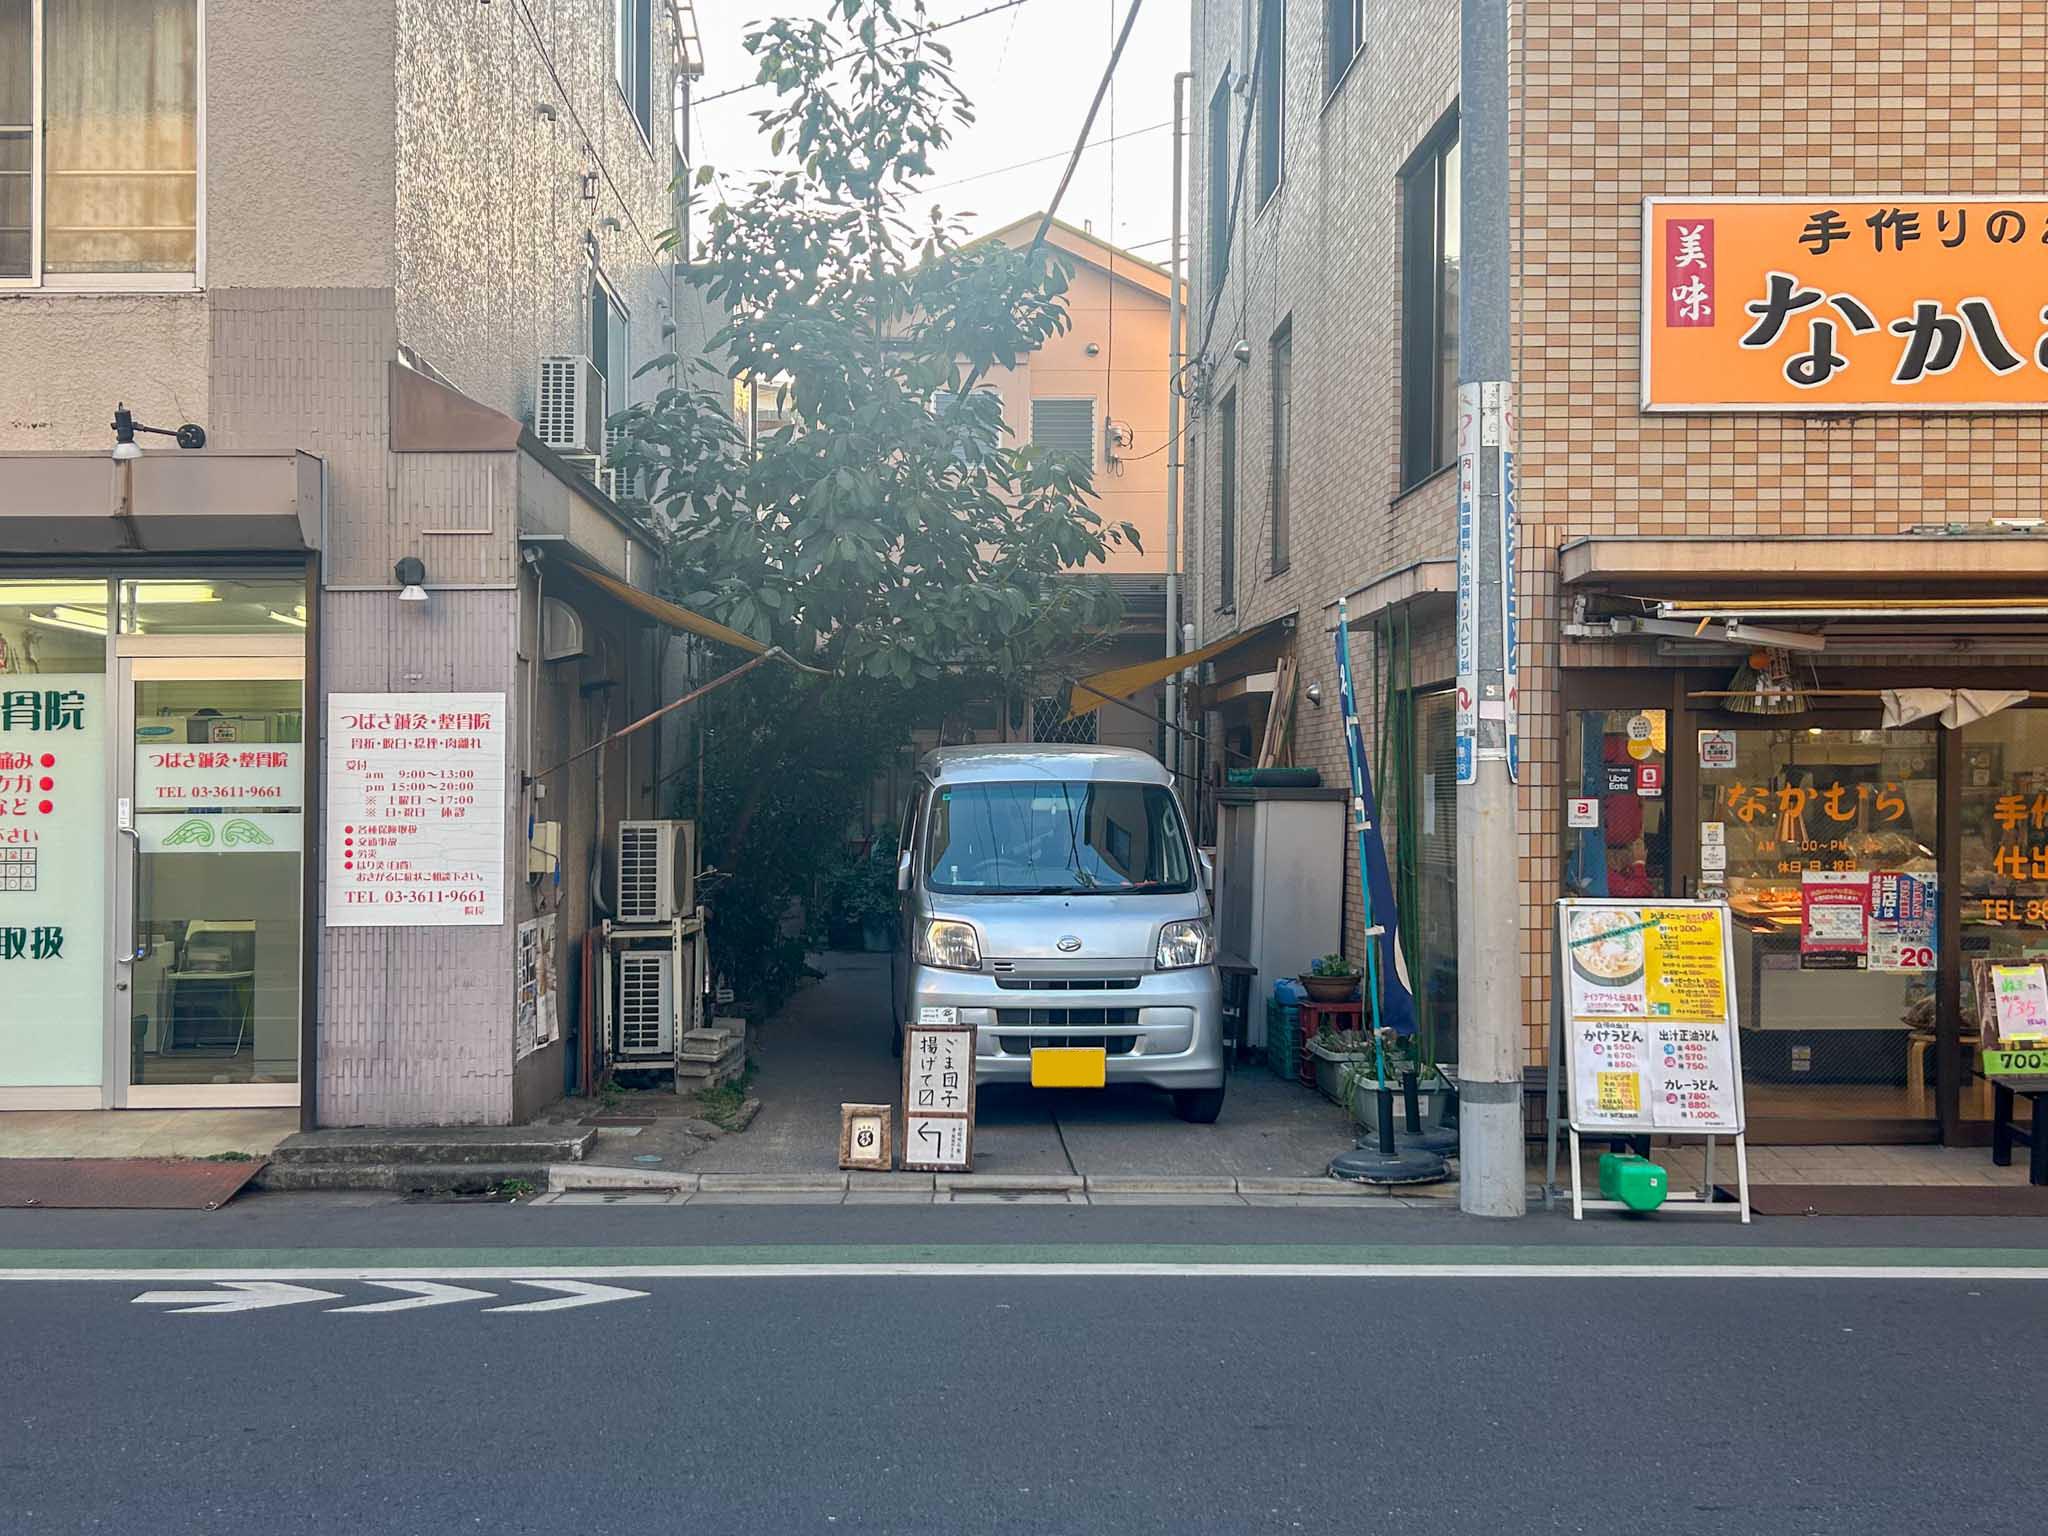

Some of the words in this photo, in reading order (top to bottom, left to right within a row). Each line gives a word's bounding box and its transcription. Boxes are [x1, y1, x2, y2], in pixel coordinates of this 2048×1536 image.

[1799, 208, 2048, 255] 手作りの
[1672, 224, 1712, 322] 美味
[1742, 274, 2048, 386] なか
[2, 690, 85, 731] 骨院
[341, 713, 491, 730] つばさ鍼灸・整骨院
[149, 752, 289, 768] つばさ鍼灸・整骨院
[1609, 774, 1629, 783] Uber
[1609, 782, 1629, 791] Eats
[155, 786, 187, 798] TEL
[1727, 780, 1906, 822] なかむら
[0, 828, 39, 844] さい
[1778, 860, 1802, 873] 休日
[345, 890, 379, 903] TEL
[385, 889, 485, 903] 03-3611-9661
[1882, 875, 1897, 918] 当店は
[1981, 899, 2021, 920] TEL
[0, 925, 64, 960] 取扱
[1584, 1030, 1643, 1043] かけうどん
[2000, 1053, 2048, 1070] 700
[940, 1038, 959, 1108] ごま団子
[1664, 1079, 1719, 1091] カレーうどん
